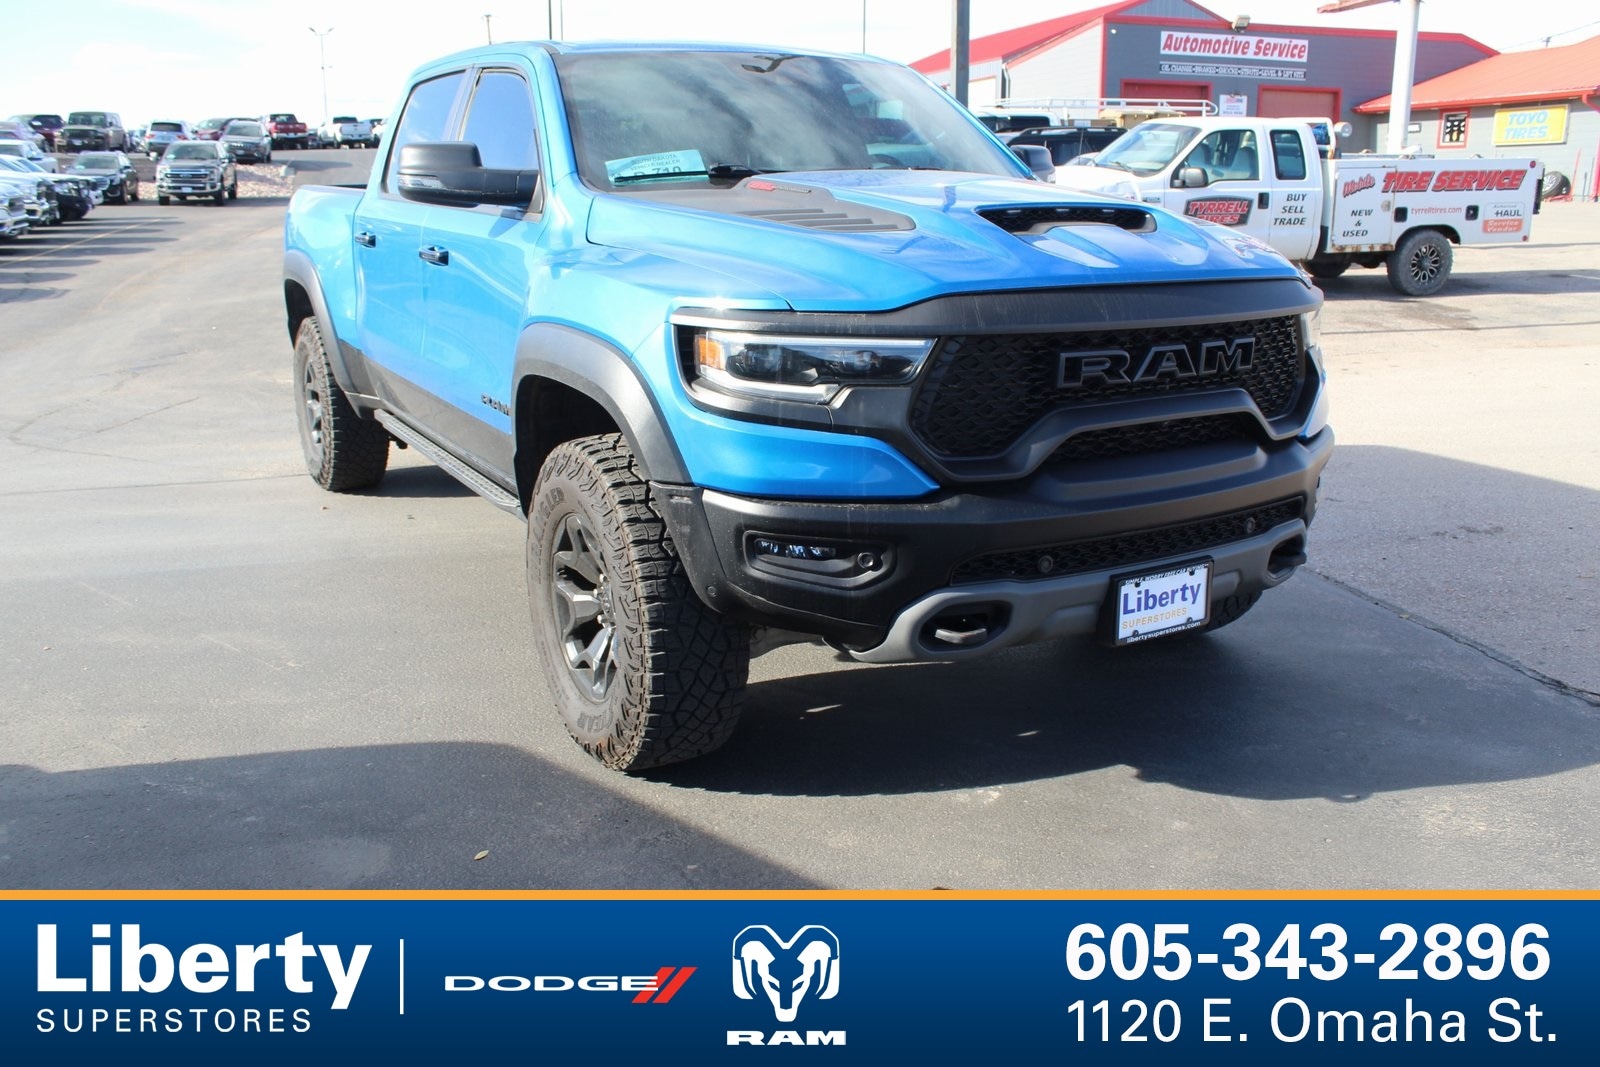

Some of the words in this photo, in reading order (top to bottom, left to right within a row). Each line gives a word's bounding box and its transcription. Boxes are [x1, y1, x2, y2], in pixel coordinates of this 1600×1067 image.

[1162, 33, 1250, 56] Automotive
[1253, 38, 1307, 60] Service
[1508, 110, 1548, 125] TOYO
[1504, 125, 1548, 140] TIRES
[1381, 171, 1435, 193] TIRE
[1431, 169, 1527, 192] SERVICE
[1286, 193, 1307, 202] BUY
[1188, 200, 1249, 215] TYRRELL
[1281, 205, 1305, 214] SELL
[1350, 208, 1374, 217] NEW
[1411, 204, 1462, 215] tyrrelltires.com
[1273, 217, 1307, 226] TRADE
[1354, 219, 1362, 227] &
[1342, 229, 1368, 238] USED
[1057, 337, 1256, 388] RAM
[481, 393, 511, 416] RAM
[1122, 583, 1202, 615] Liberty
[1122, 607, 1187, 630] SUPERSTORES
